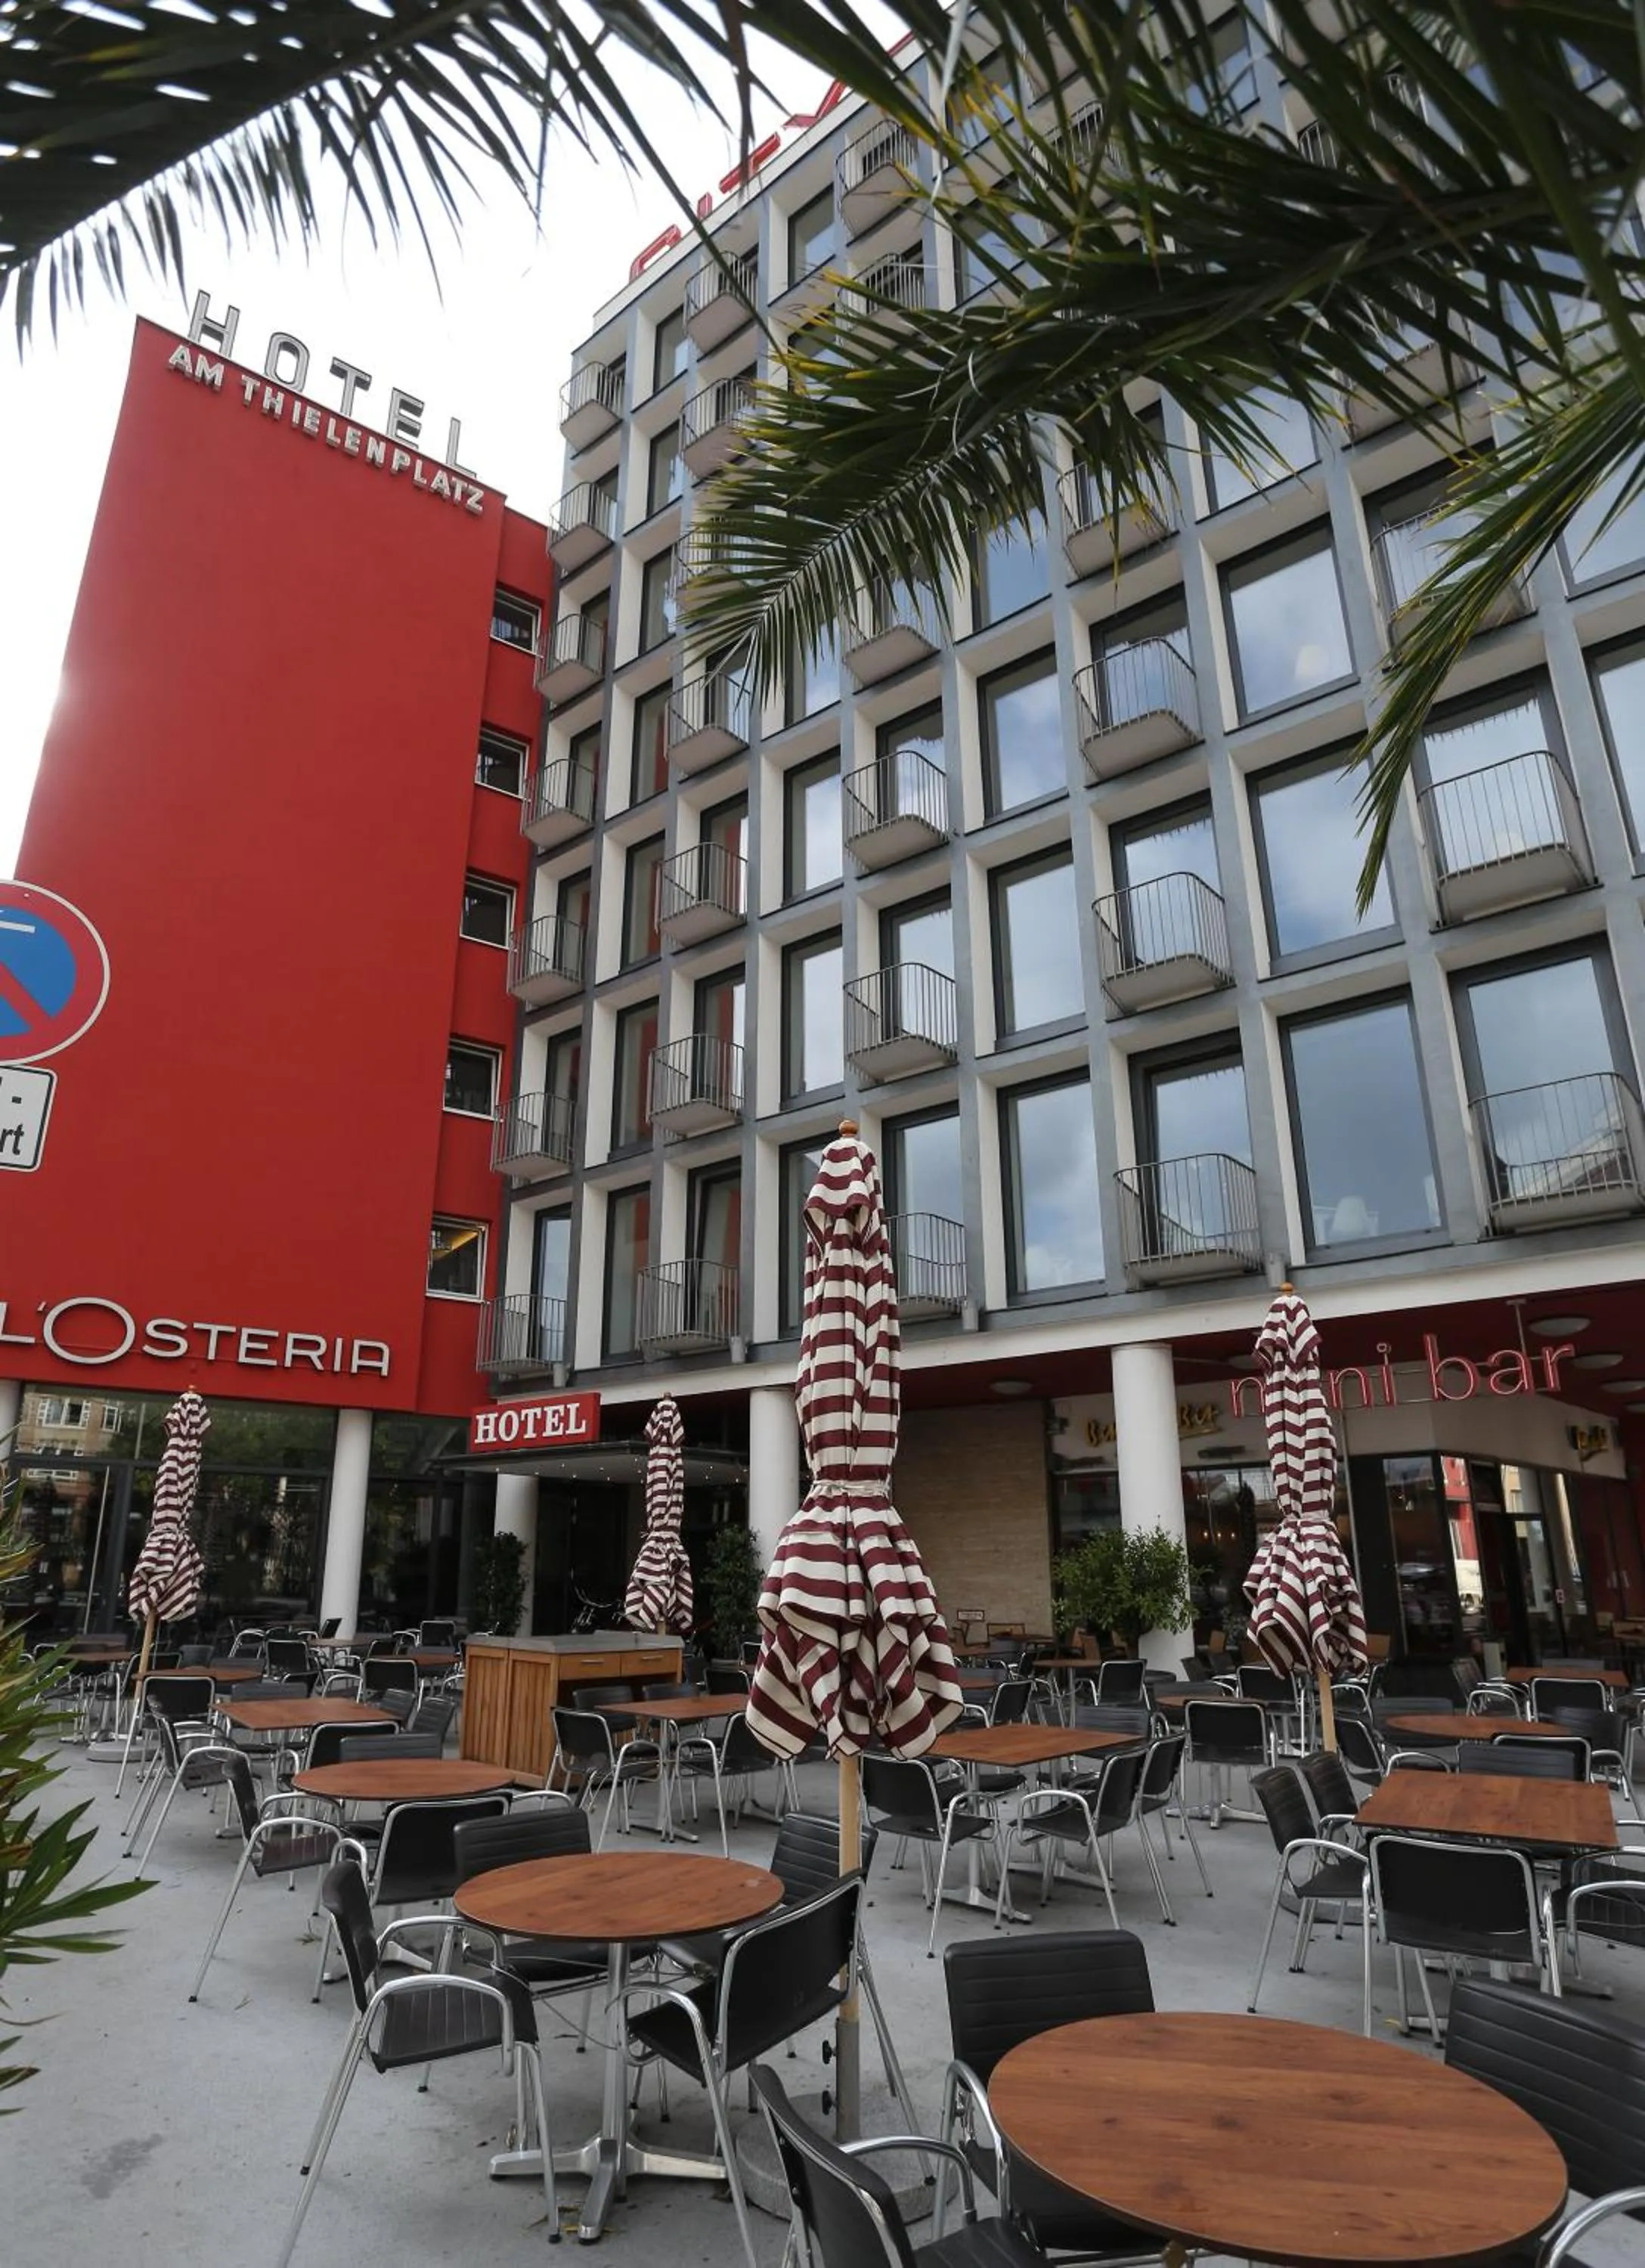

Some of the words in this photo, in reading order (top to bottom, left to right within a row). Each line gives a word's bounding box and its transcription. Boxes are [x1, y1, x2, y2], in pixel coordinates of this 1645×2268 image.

[187, 289, 477, 478] HOTEL
[169, 344, 225, 391] AM
[241, 374, 485, 516] THIELENPLATZ
[0, 1297, 390, 1377] L'OSTERIA
[1231, 1343, 1397, 1418] mni
[1423, 1333, 1575, 1400] bar
[475, 1402, 587, 1444] HOTEL
